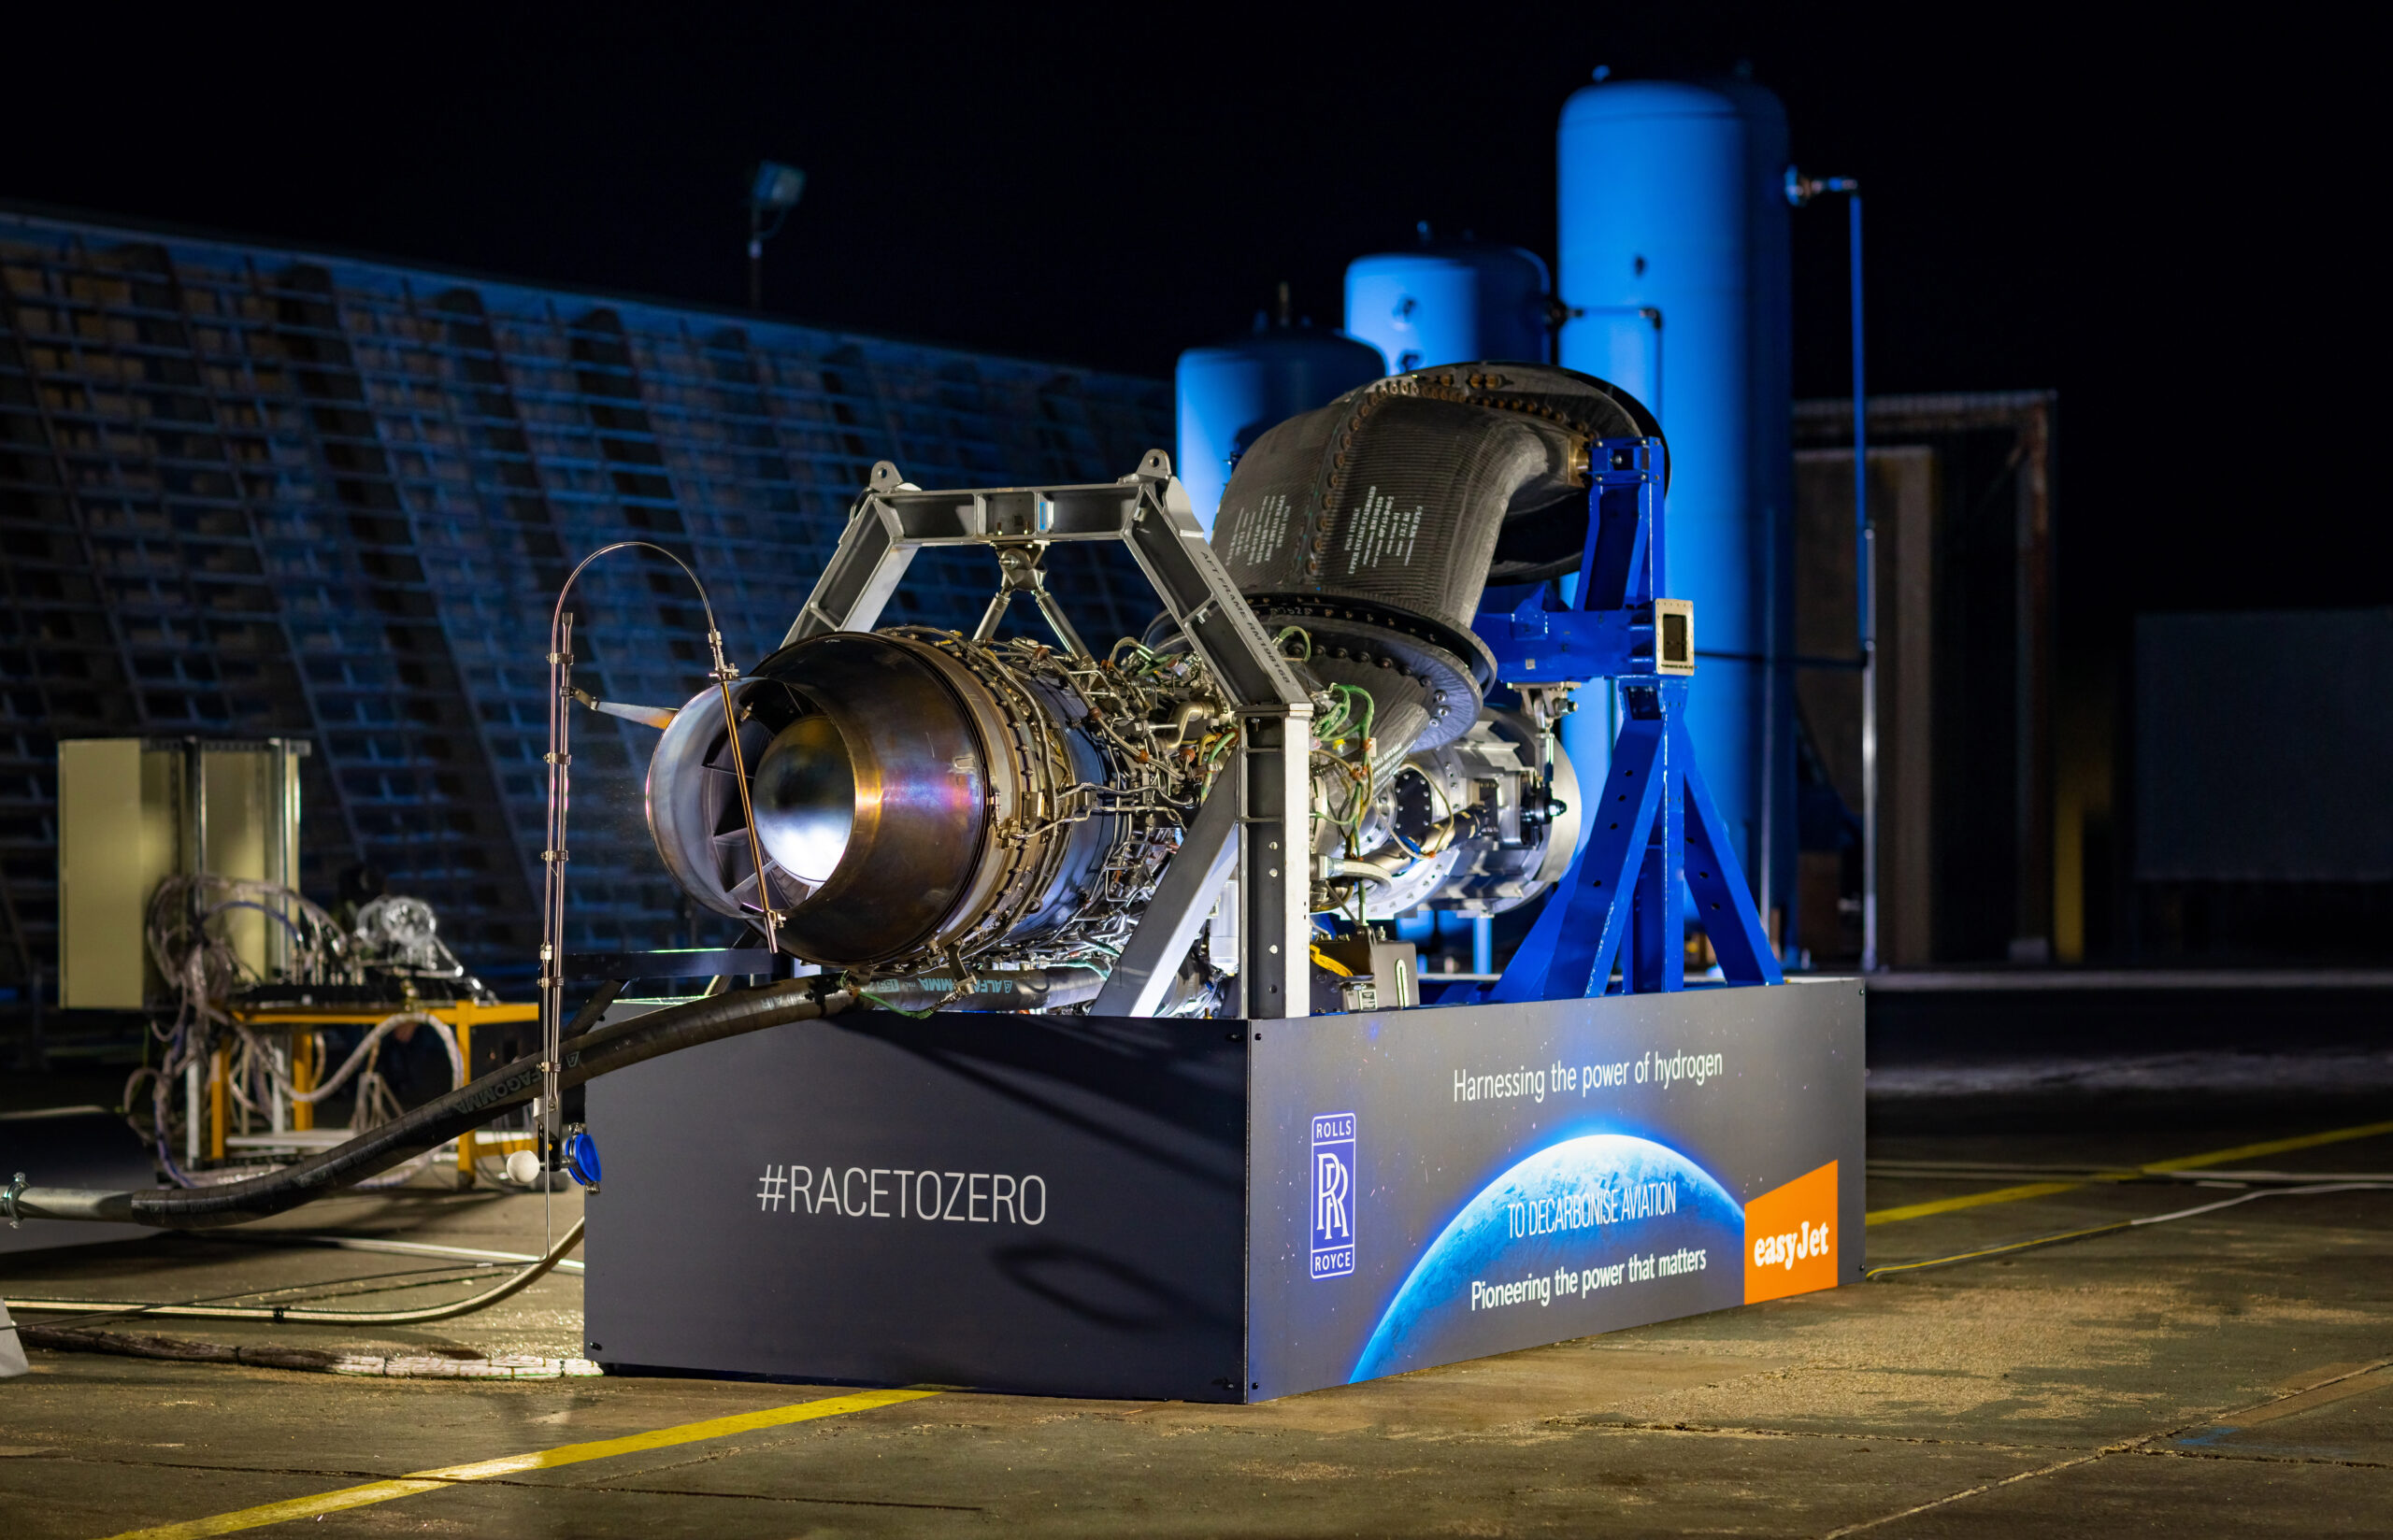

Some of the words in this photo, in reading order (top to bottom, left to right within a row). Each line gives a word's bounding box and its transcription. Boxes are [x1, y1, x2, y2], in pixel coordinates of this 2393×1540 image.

[1348, 551, 1359, 574] UPPER
[1354, 525, 1366, 550] INTAKE
[1361, 486, 1377, 524] STARBOARD
[1349, 507, 1361, 533] INTAKE
[1200, 551, 1220, 574] AFT
[1217, 577, 1246, 620] FRAME
[1454, 1065, 1544, 1103] Harnessing
[1551, 1060, 1576, 1092] the
[1583, 1062, 1629, 1097] power
[1635, 1051, 1651, 1084] of
[1655, 1048, 1723, 1090] hydrogen
[1316, 1120, 1352, 1138] ROLLS
[756, 1164, 1046, 1225] #RACETOZERO
[1508, 1202, 1526, 1239] TO
[1528, 1189, 1619, 1236] DECARBONISE
[1620, 1180, 1676, 1221] AVIATION
[1314, 1251, 1351, 1272] ROYCE
[1754, 1220, 1829, 1271] easyJet
[1471, 1273, 1551, 1311] Pioneering
[1555, 1266, 1578, 1296] the
[1583, 1263, 1625, 1300] power
[1628, 1253, 1655, 1283] that
[1658, 1248, 1707, 1277] matters
